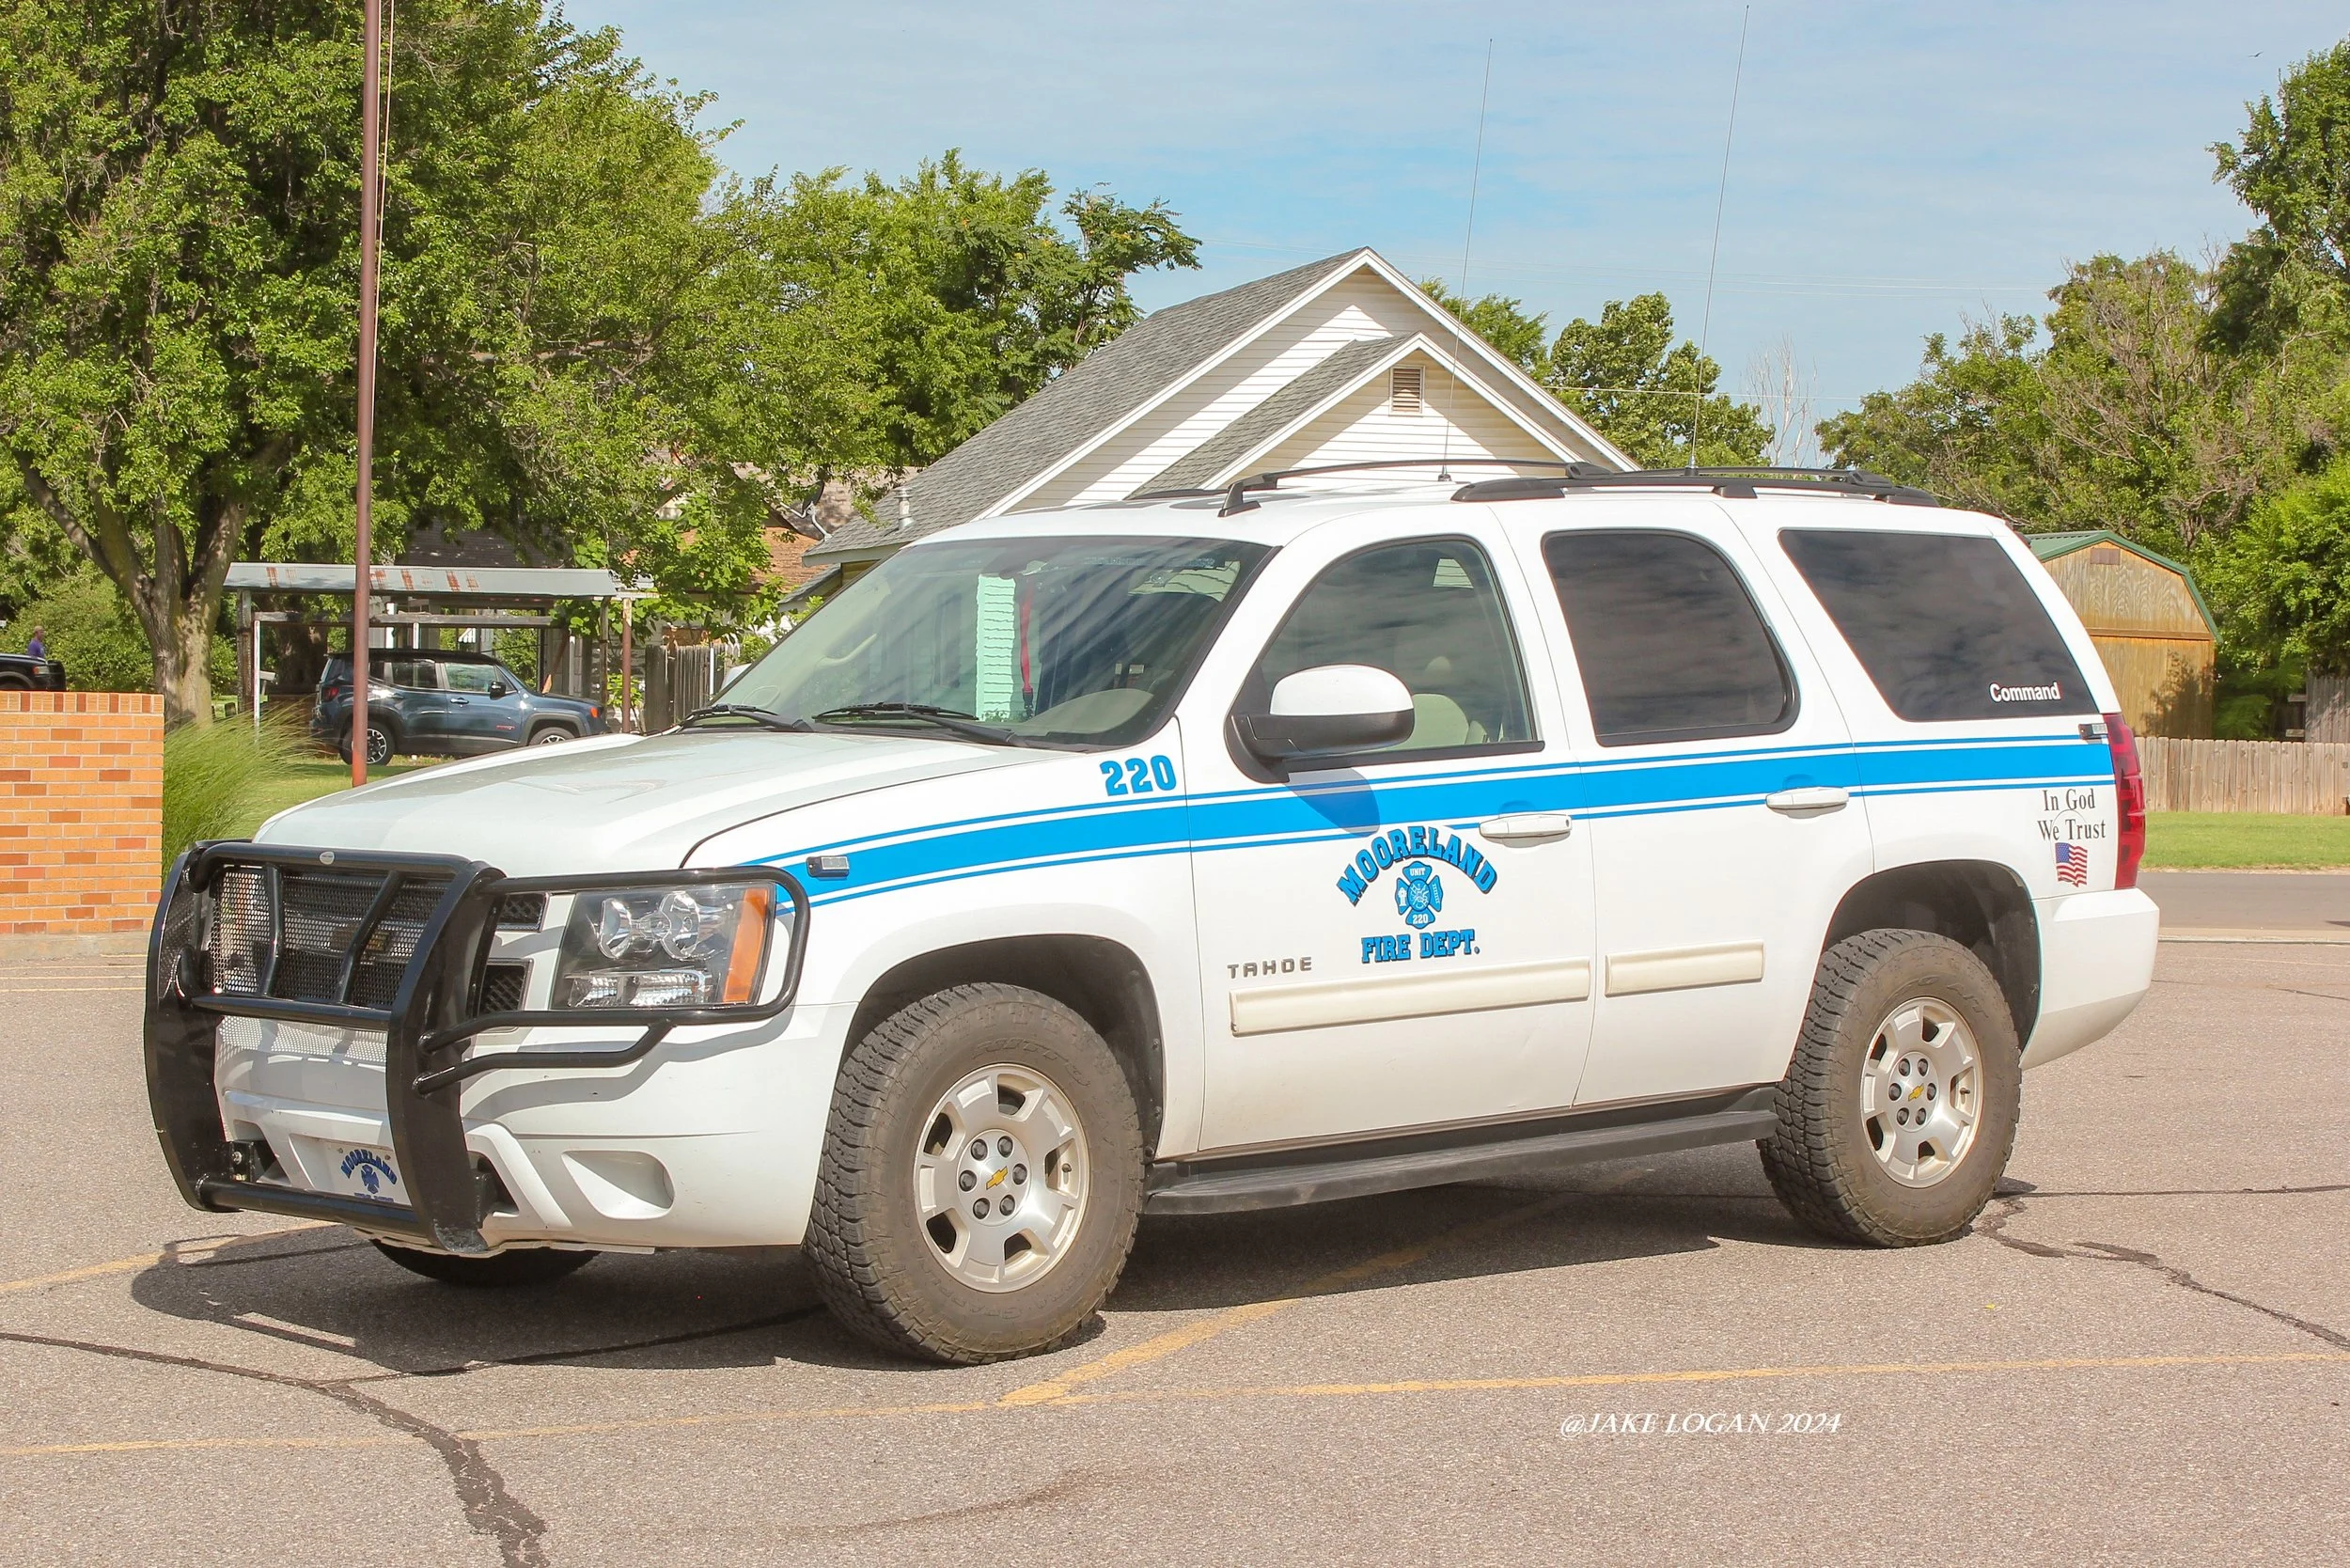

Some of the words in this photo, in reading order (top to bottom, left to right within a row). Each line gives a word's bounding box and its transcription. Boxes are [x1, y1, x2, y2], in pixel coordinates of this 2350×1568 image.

[1989, 682, 2061, 703] Command
[1099, 755, 1177, 796] 220
[2043, 790, 2060, 811] In
[2065, 788, 2096, 810] God
[2037, 820, 2060, 840] We
[2065, 819, 2107, 840] Trust
[1336, 825, 1497, 907] MOORELAND
[1410, 867, 1426, 877] UNIT
[1412, 914, 1429, 924] 220
[1361, 933, 1411, 964] FIRE
[1419, 929, 1480, 959] DEPT.
[1227, 957, 1312, 980] TAHOE
